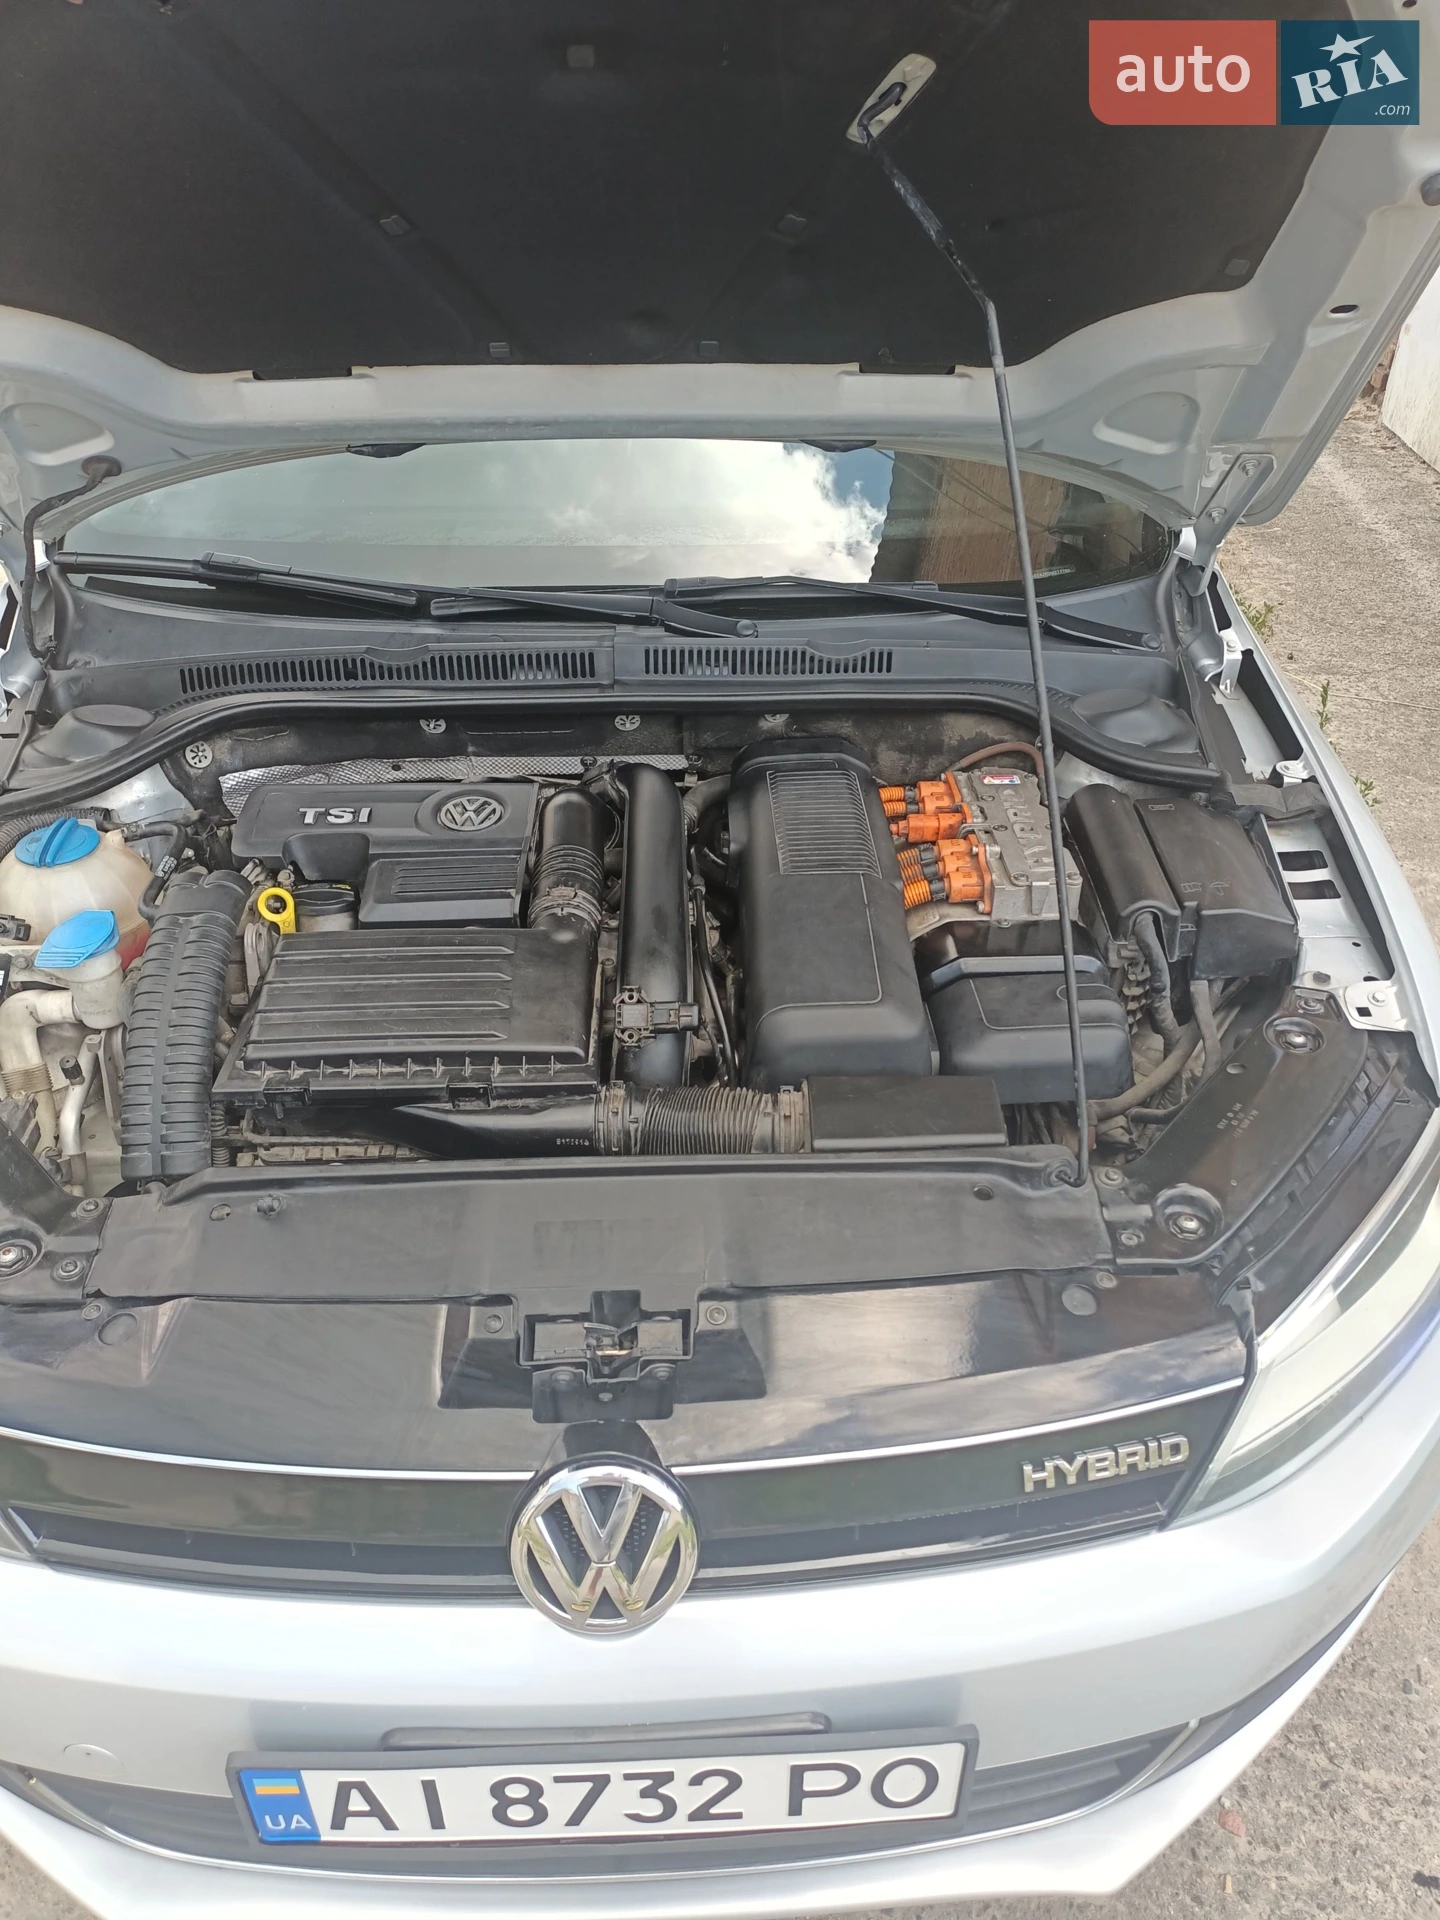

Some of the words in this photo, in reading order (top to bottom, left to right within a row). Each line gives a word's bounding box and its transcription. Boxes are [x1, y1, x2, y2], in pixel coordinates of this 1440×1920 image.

[298, 807, 373, 825] TSI
[1022, 1434, 1190, 1493] HYBRID
[511, 1465, 697, 1635] VW
[264, 1814, 312, 1830] UA
[330, 1779, 447, 1831] AI
[489, 1768, 744, 1828] 8732
[787, 1757, 940, 1817] PO
